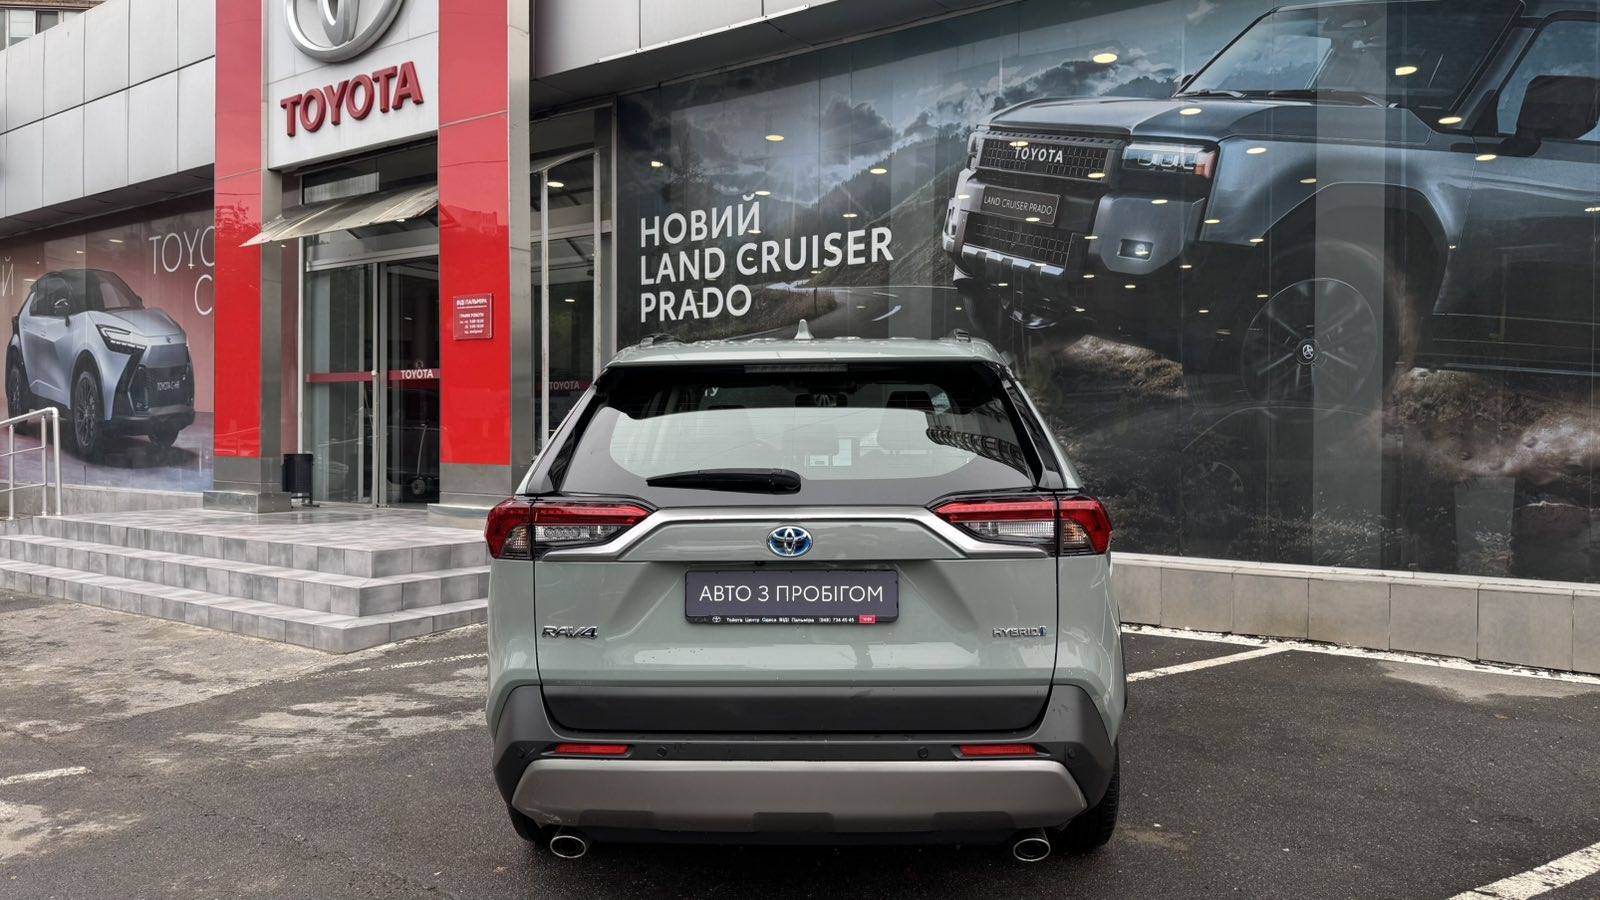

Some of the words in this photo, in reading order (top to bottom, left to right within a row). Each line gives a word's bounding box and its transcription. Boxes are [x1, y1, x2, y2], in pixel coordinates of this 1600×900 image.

[280, 61, 424, 138] TOYOTA
[1014, 147, 1063, 164] TOYOTA
[984, 195, 1000, 206] LAND
[1001, 199, 1028, 211] CRUISER
[1029, 202, 1053, 215] PRADO
[640, 193, 760, 248] НОВИЙ
[640, 247, 725, 286] LAND
[736, 226, 894, 276] CRUISER
[640, 284, 752, 323] PRADO
[400, 368, 434, 379] TOYOTA
[549, 380, 580, 390] TOYOTA
[699, 585, 752, 602] АВТО
[758, 585, 770, 602] З
[776, 585, 884, 602] ПРОБІГОМ
[542, 625, 598, 639] RAV4
[992, 627, 1040, 638] HYBRID
